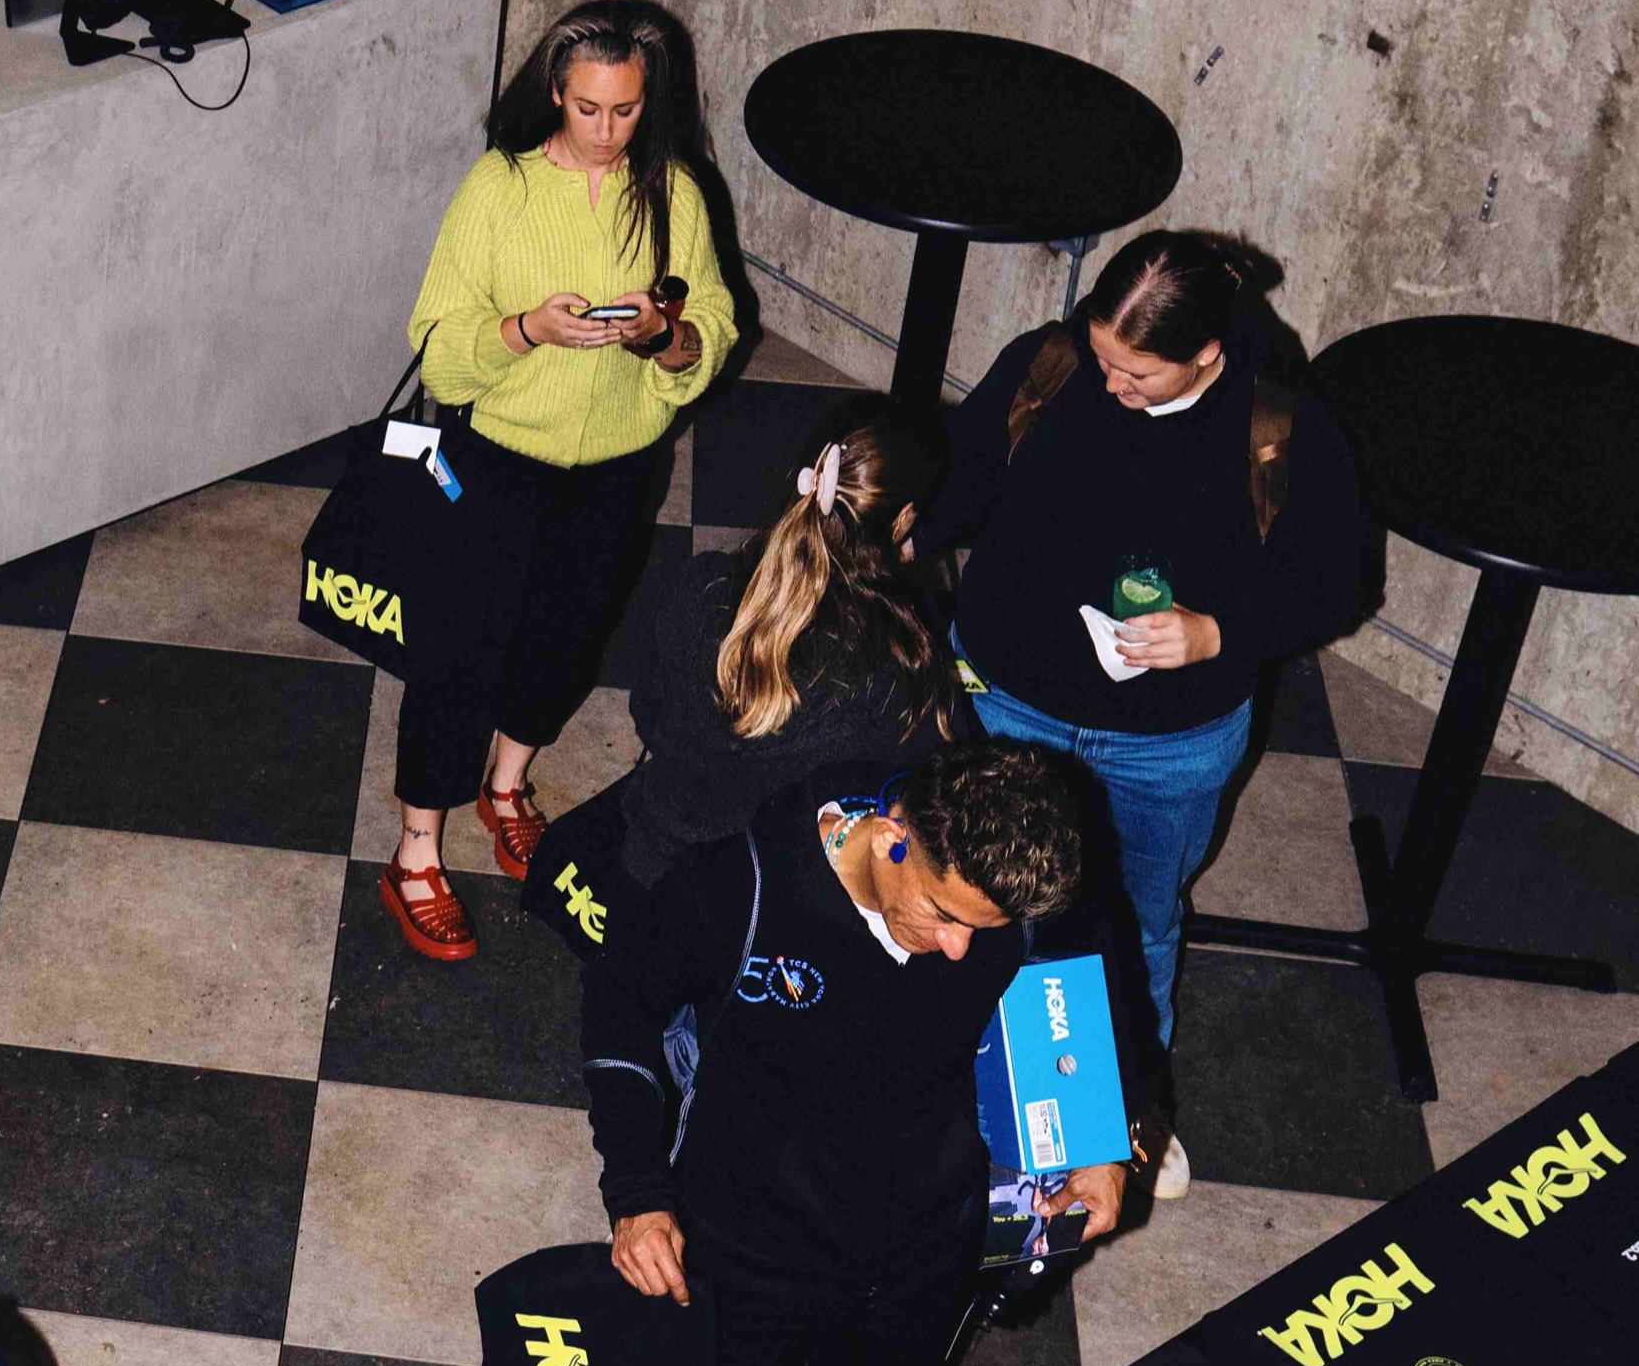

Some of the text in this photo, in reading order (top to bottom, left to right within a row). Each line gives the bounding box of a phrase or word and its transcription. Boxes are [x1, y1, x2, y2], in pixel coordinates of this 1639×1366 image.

[305, 560, 402, 642] HOKA
[789, 959, 808, 969] TCS
[809, 966, 824, 984] NEW
[765, 965, 788, 1007] MARATHON
[810, 984, 825, 1004] YORK
[1043, 978, 1069, 1041] HOKA
[1465, 1114, 1624, 1237] HOKA
